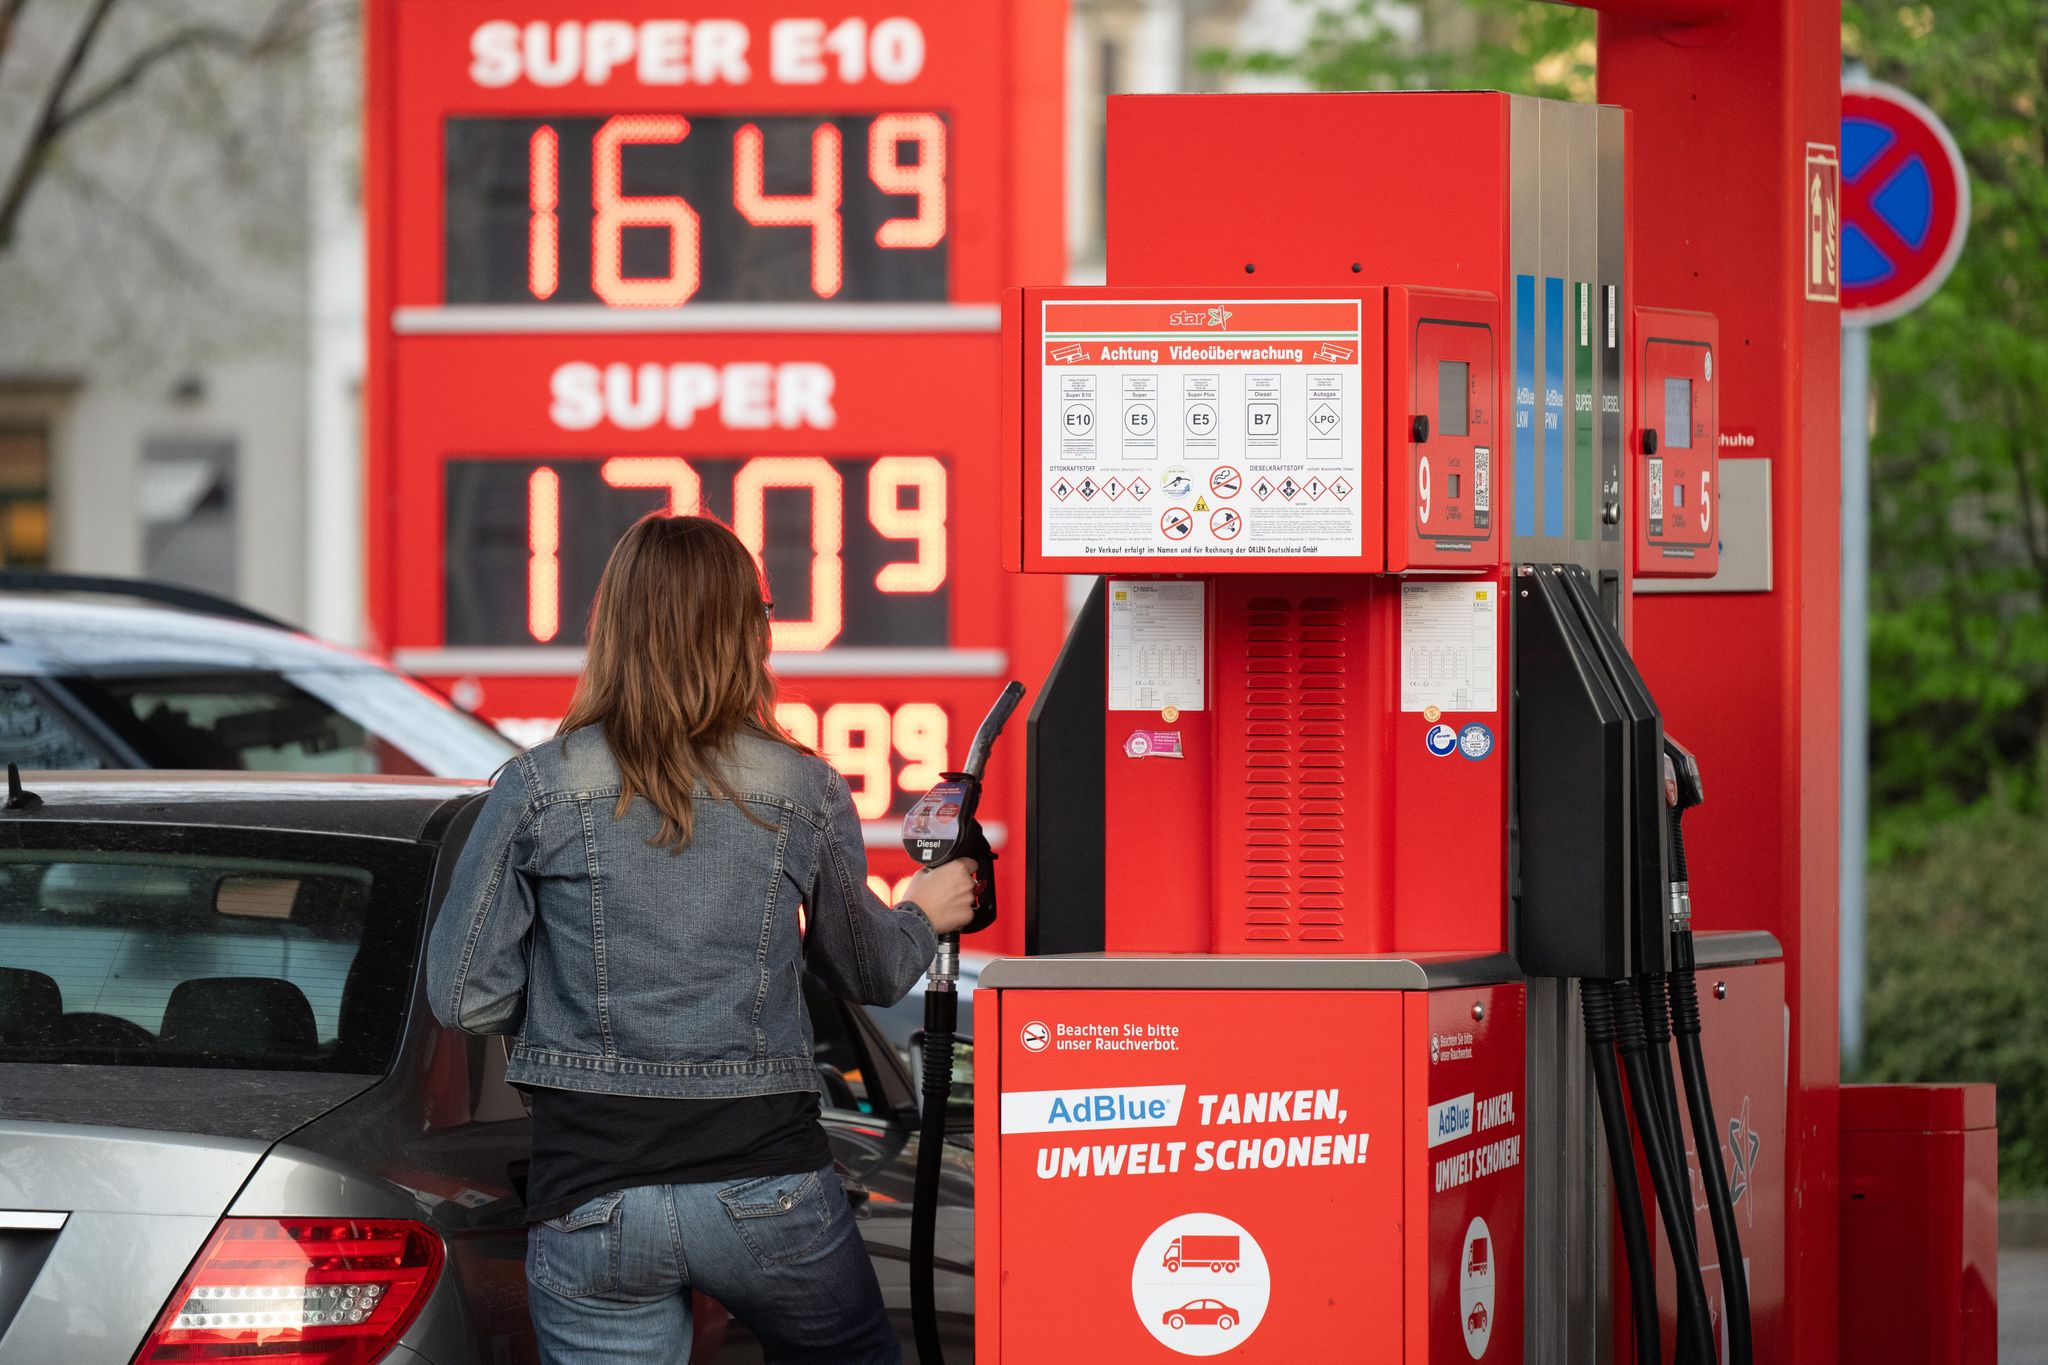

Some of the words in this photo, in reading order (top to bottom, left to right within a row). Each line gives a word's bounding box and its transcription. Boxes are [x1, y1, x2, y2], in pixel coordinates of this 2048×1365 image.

[468, 20, 750, 87] SUPER
[769, 17, 925, 85] E10
[1169, 310, 1206, 326] star
[1100, 345, 1159, 363] Achtung
[1169, 345, 1303, 363] Videoüberwachung
[549, 361, 836, 430] SUPER
[1517, 388, 1535, 405] AdBlue
[1545, 389, 1564, 407] AdBlue
[1576, 394, 1592, 411] SUPER
[1602, 395, 1619, 412] DIESEL
[1066, 414, 1091, 426] E10
[1131, 414, 1148, 426] E5
[1192, 414, 1209, 425] E5
[1254, 414, 1271, 425] B7
[1314, 415, 1335, 424] LPG
[1517, 411, 1528, 428] LKW
[1545, 412, 1557, 429] PKW
[1718, 433, 1754, 447] huhe
[1419, 456, 1431, 524] 9
[1700, 471, 1710, 532] 5
[1085, 546, 1096, 554] Der
[1098, 546, 1123, 554] Verkauf
[1124, 546, 1145, 555] erfolgt
[1147, 546, 1155, 554] im
[1157, 546, 1178, 554] Namen
[1181, 546, 1192, 554] und
[1194, 546, 1203, 554] für
[1205, 546, 1233, 555] Rechnung
[1236, 546, 1246, 554] der
[1248, 546, 1266, 554] ORLEN
[1267, 546, 1301, 554] Deutschland
[1302, 546, 1318, 554] GmbH
[917, 839, 940, 848] Diesel
[1057, 1023, 1119, 1037] Beachten
[1123, 1023, 1143, 1037] Sie
[1147, 1023, 1179, 1037] bitte
[1056, 1038, 1091, 1051] unser
[1095, 1037, 1179, 1052] Rauchverbot.
[1198, 1088, 1348, 1126] TANKEN,
[1476, 1091, 1515, 1133] TANKEN,
[1036, 1141, 1187, 1180] UMWELT
[1194, 1133, 1370, 1172] SCHONEN!
[1435, 1149, 1474, 1193] UMWELT
[1475, 1134, 1520, 1179] SCHONEN!
